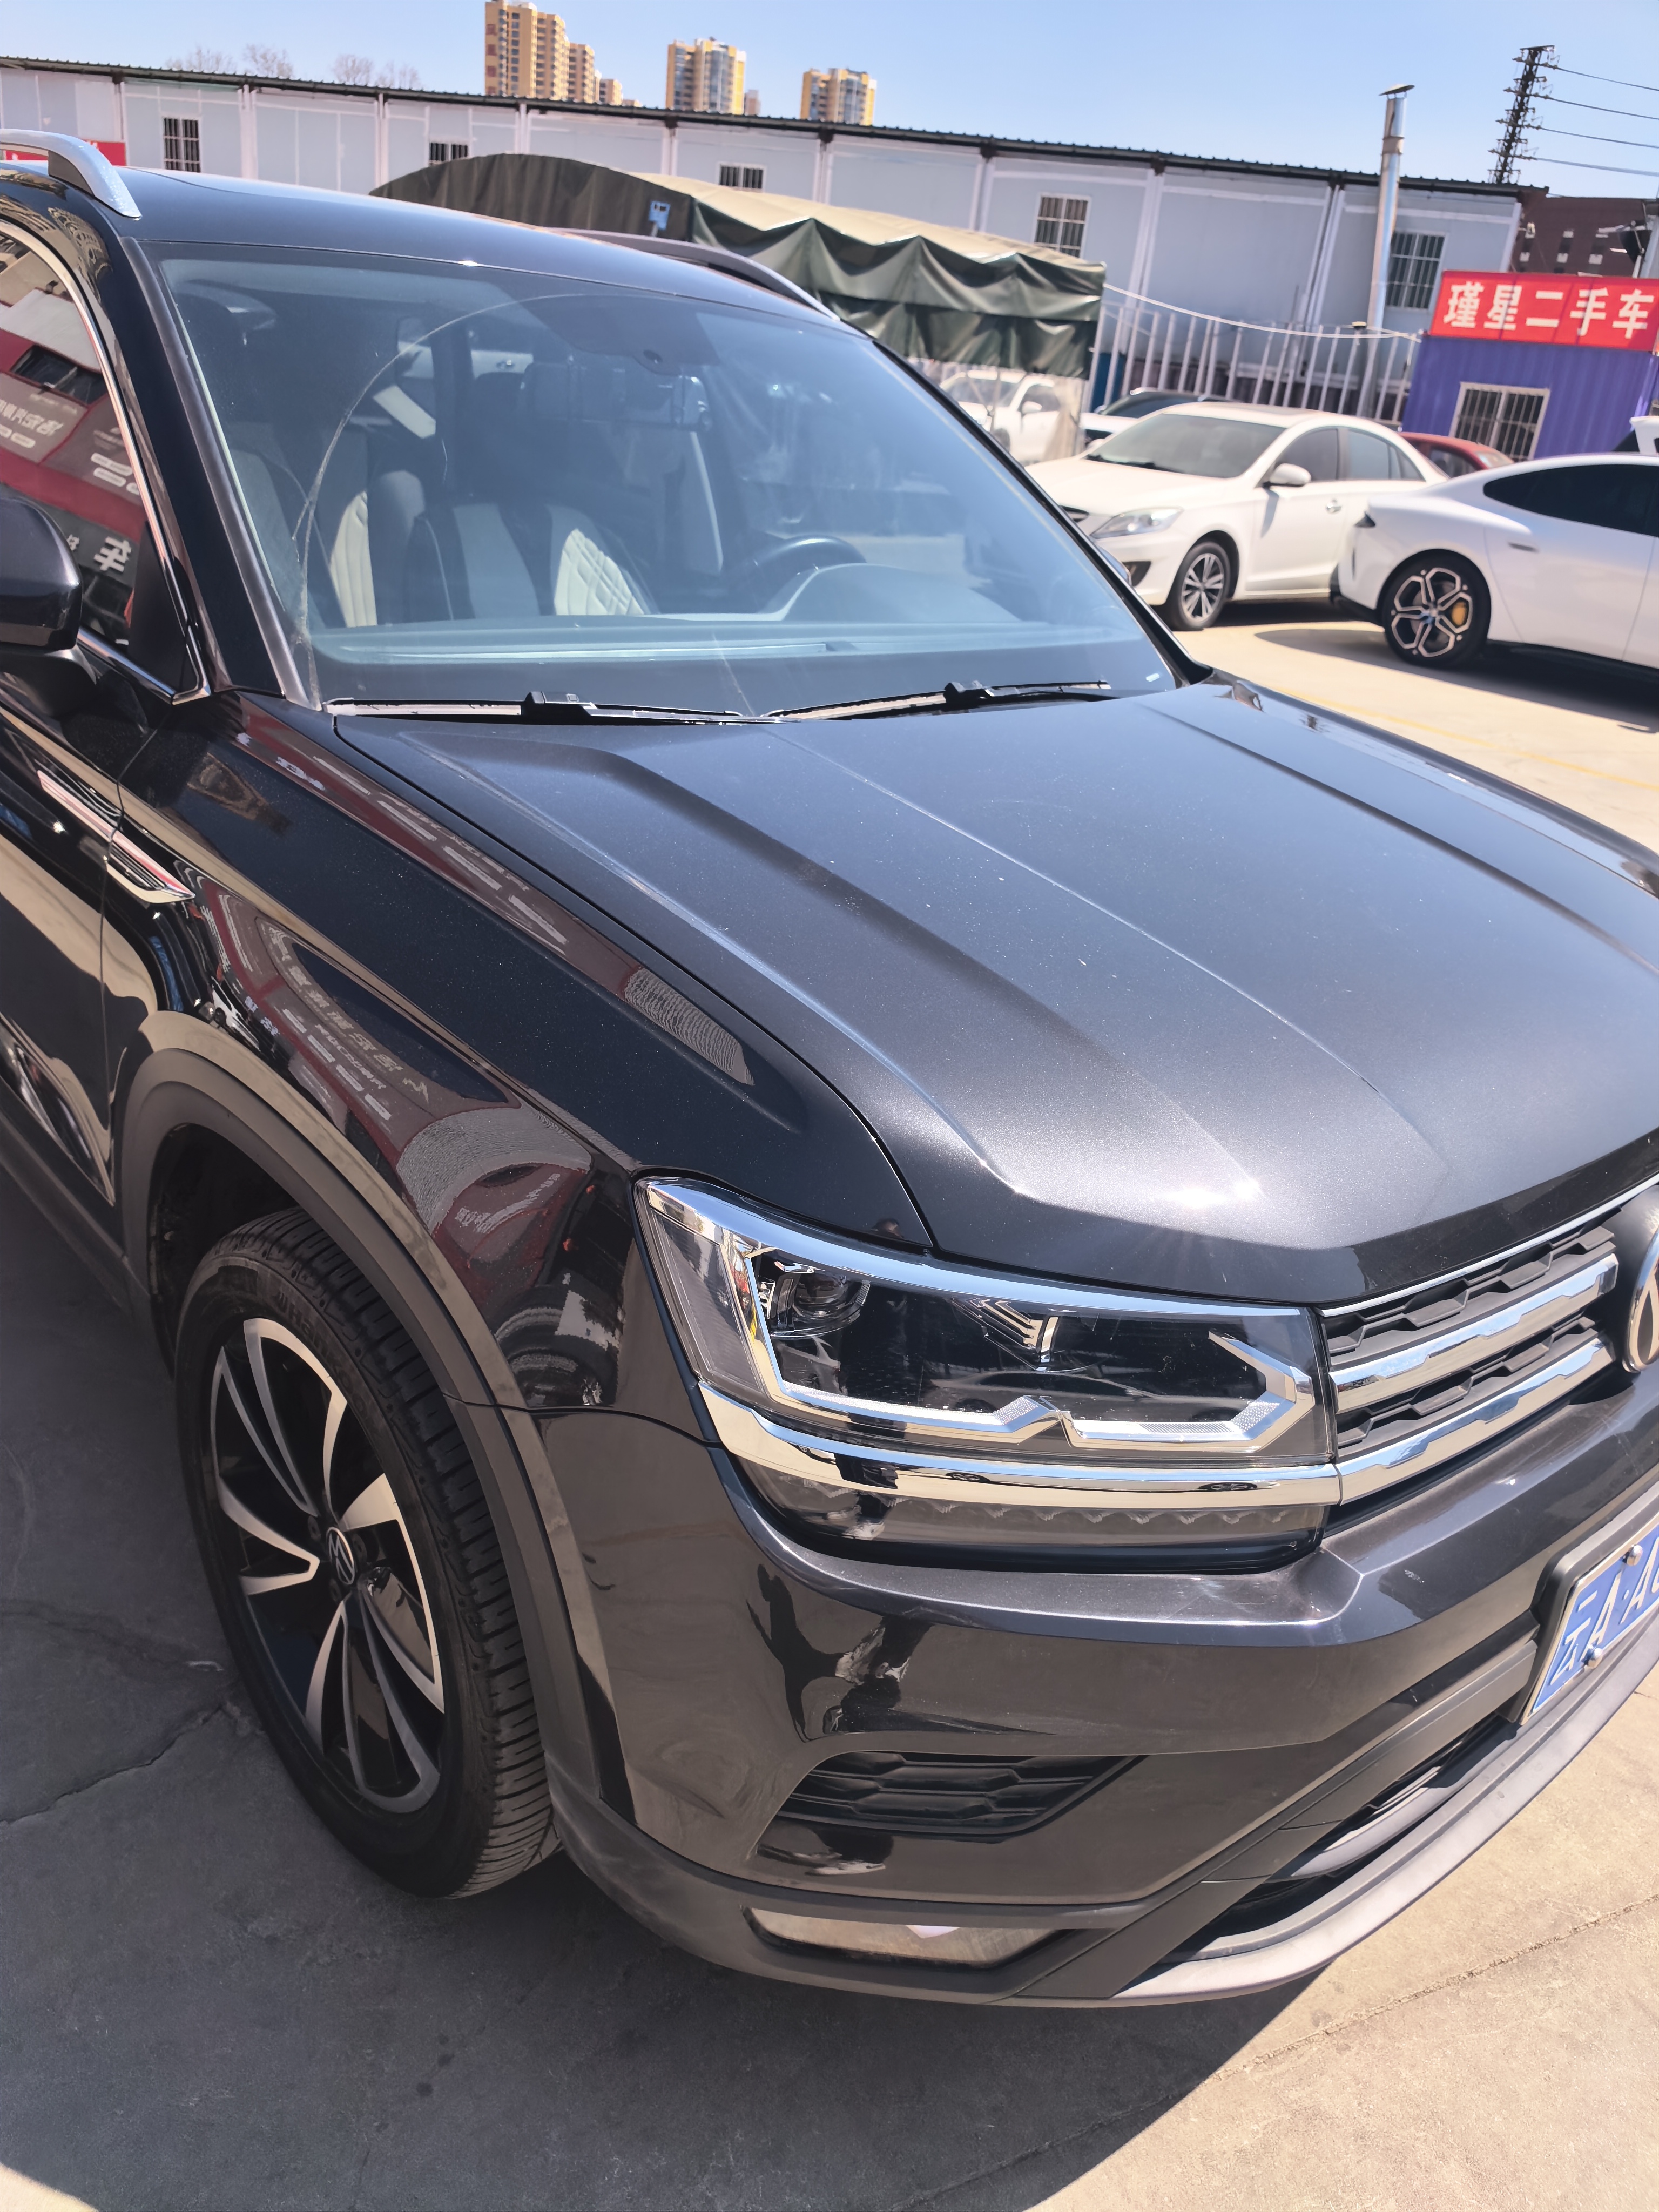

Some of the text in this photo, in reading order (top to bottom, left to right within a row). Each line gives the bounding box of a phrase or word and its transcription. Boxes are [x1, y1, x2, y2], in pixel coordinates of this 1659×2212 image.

[1444, 281, 1654, 339] 瑾星二手车
[1549, 1536, 1659, 1685] 云A·A
